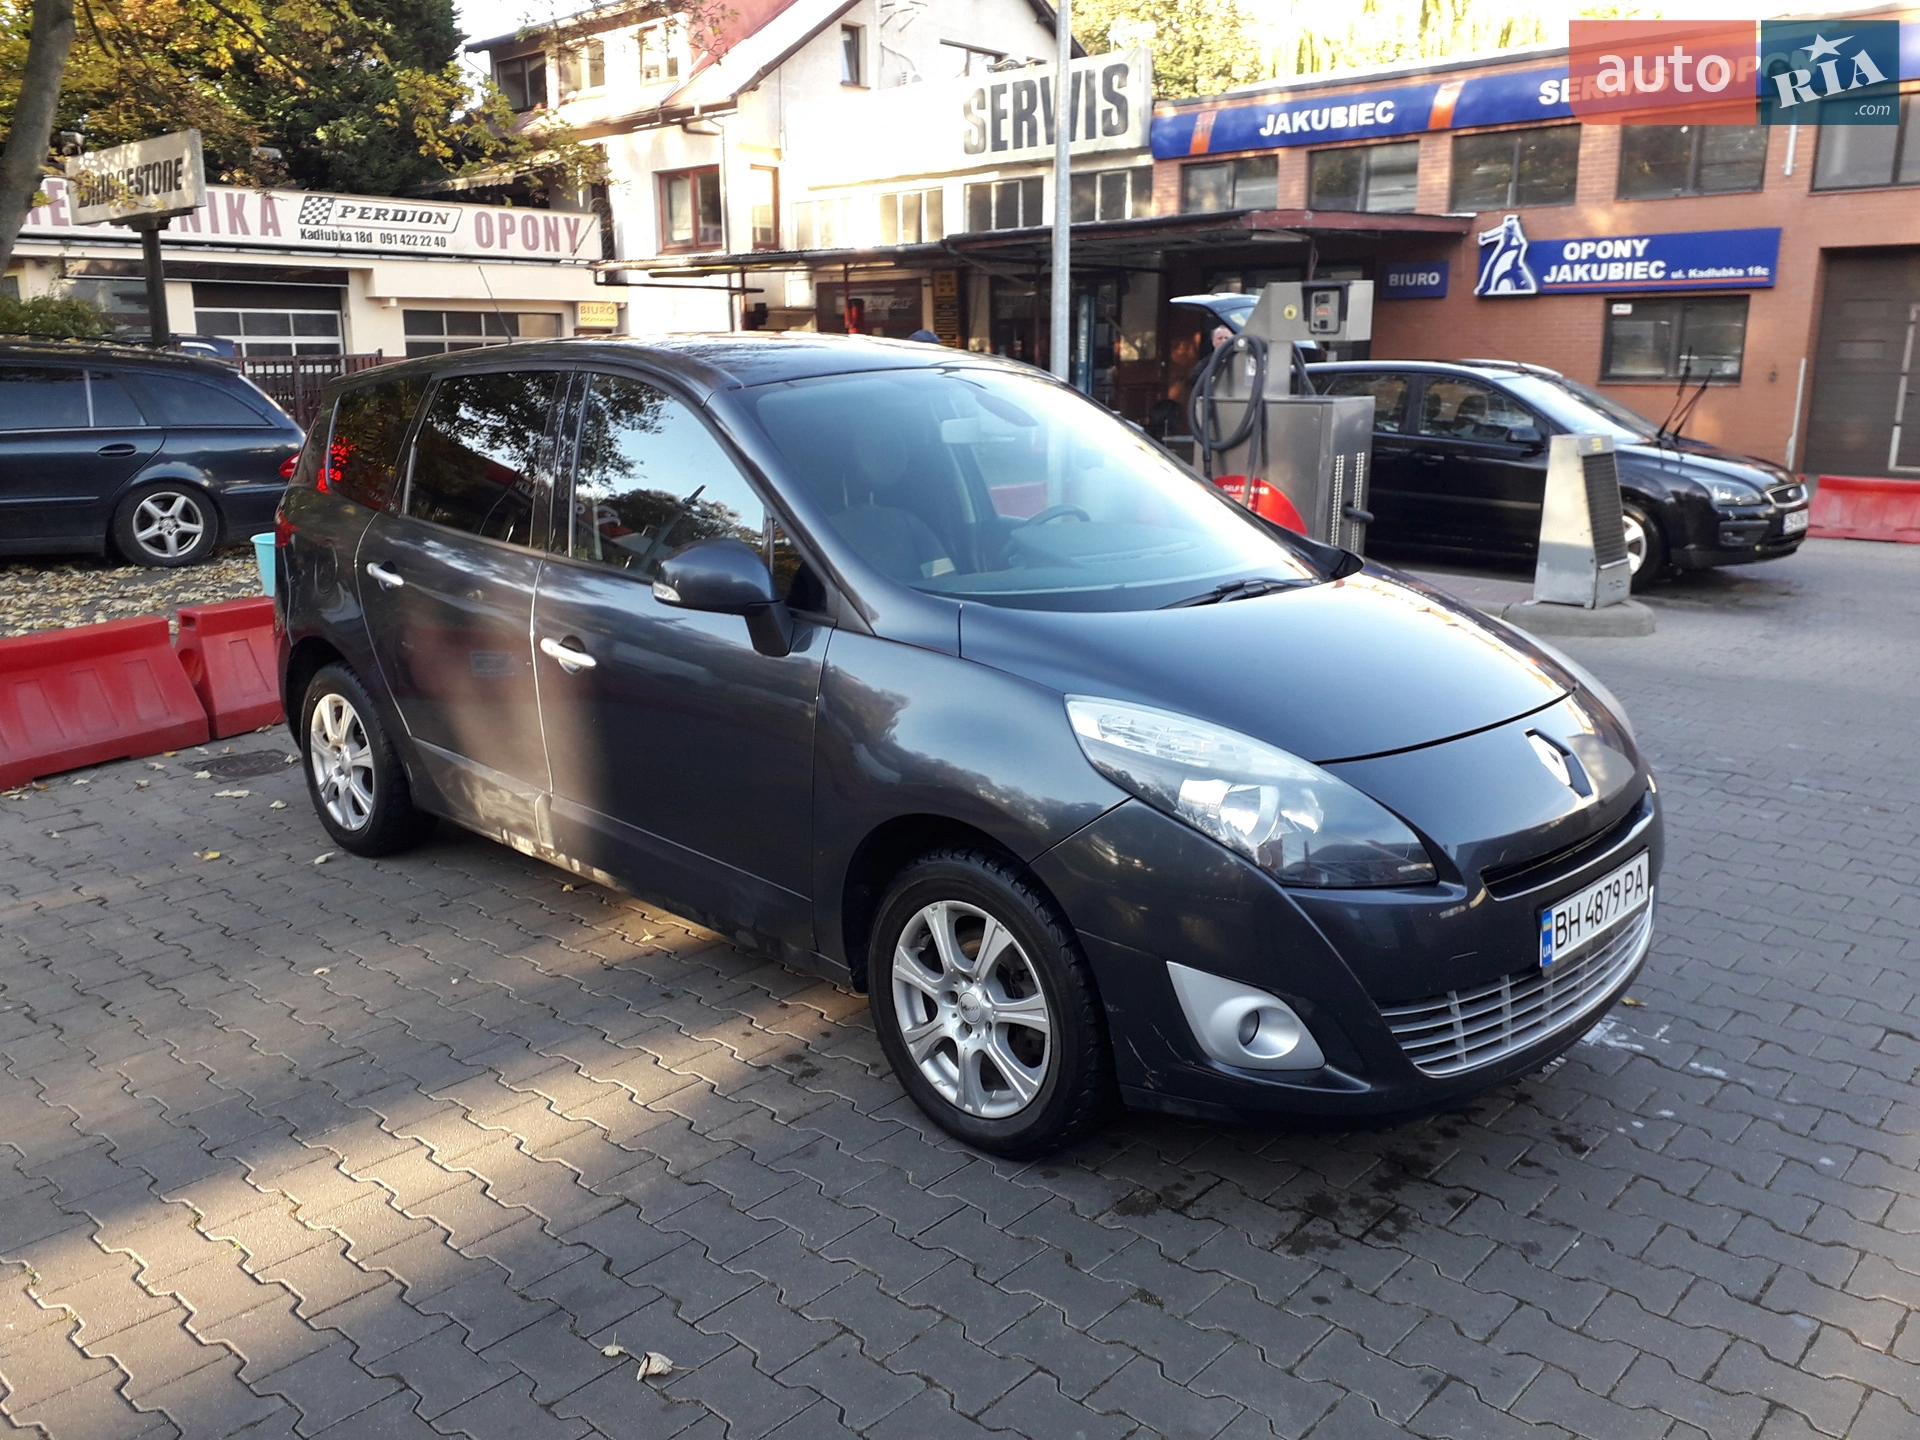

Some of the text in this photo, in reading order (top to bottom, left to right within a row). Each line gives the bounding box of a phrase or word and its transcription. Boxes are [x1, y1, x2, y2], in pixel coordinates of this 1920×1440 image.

[1259, 100, 1395, 137] JAKUBIEC
[338, 205, 450, 225] PERDJON
[354, 231, 373, 243] 18d
[380, 233, 398, 245] 091
[434, 236, 446, 248] 40
[474, 211, 581, 253] OPONY
[1563, 238, 1650, 261] OPONY
[1388, 272, 1441, 287] BIURO
[1543, 260, 1667, 283] JAKUBIEC
[580, 306, 615, 315] BIURO
[1555, 864, 1644, 950] BH 4879 PA
